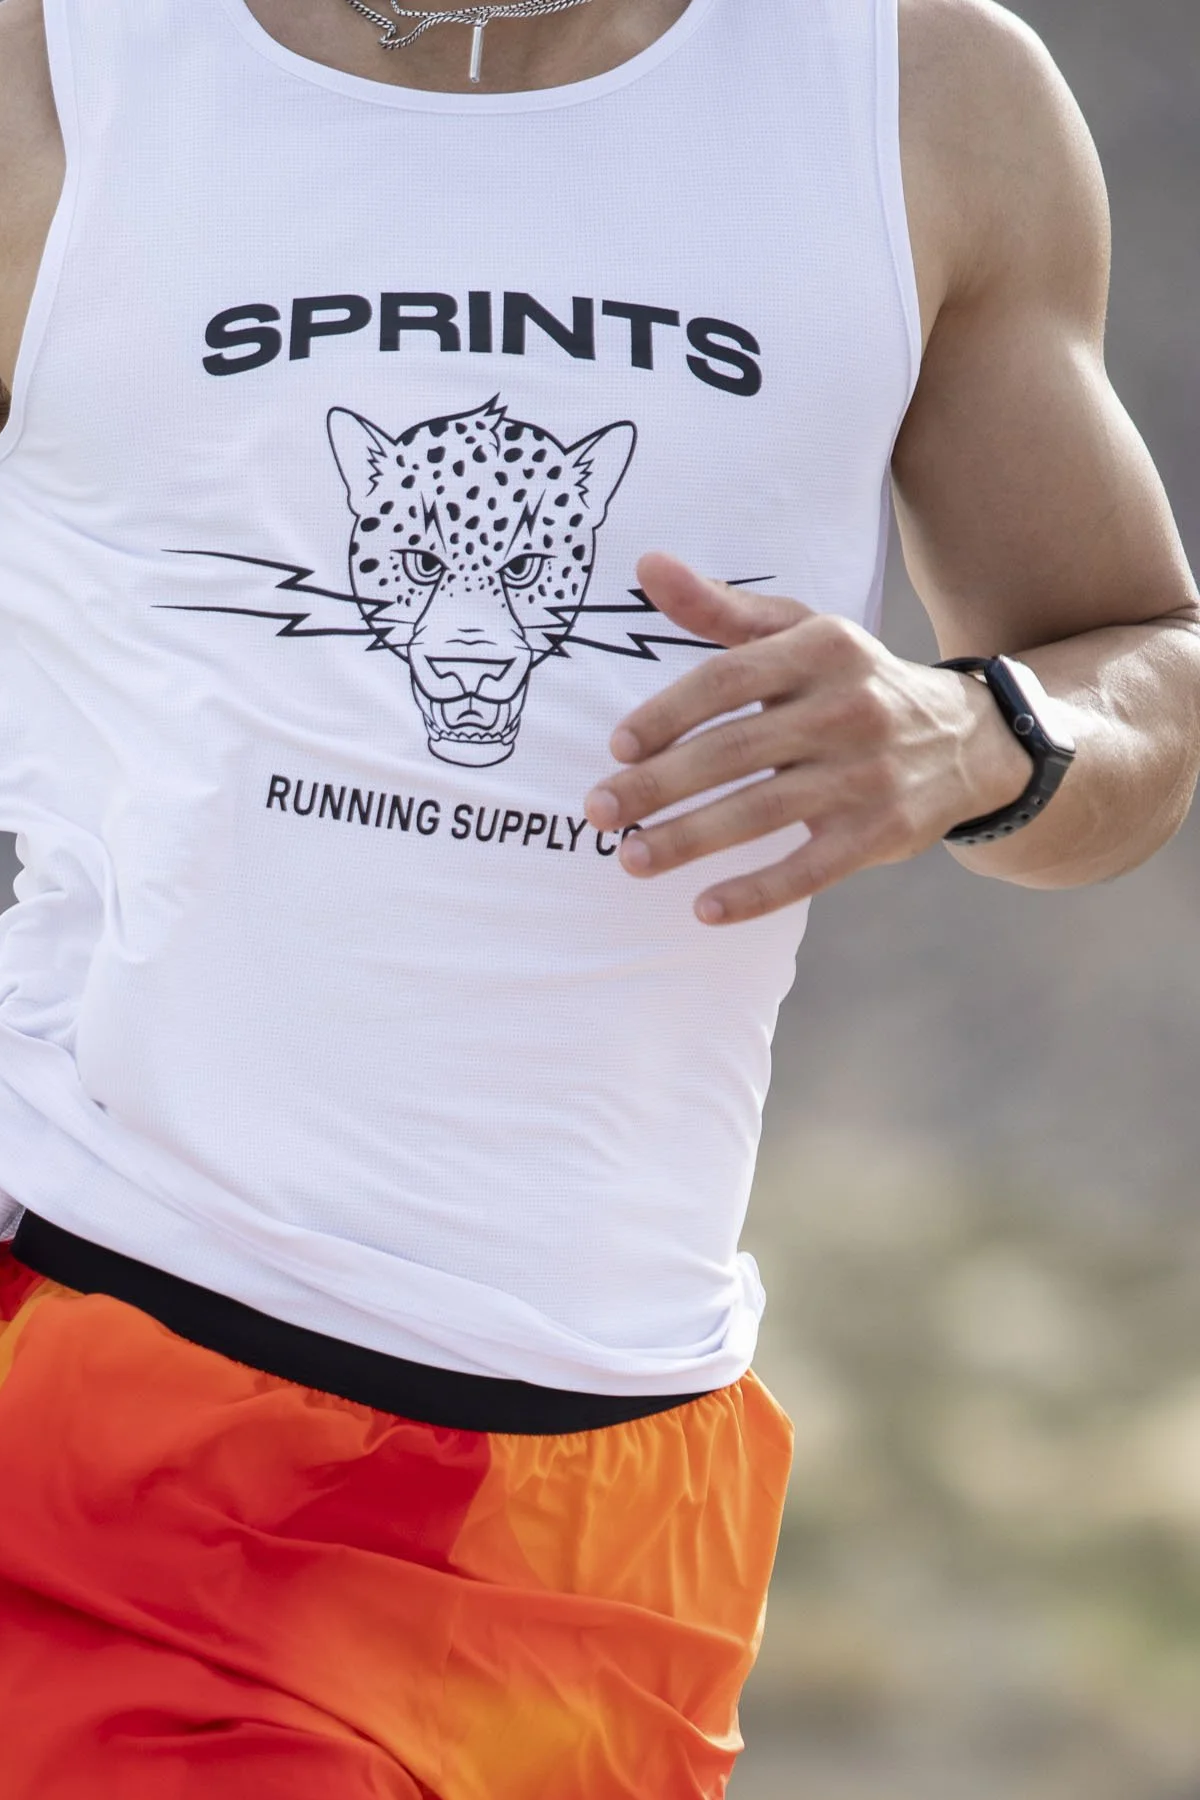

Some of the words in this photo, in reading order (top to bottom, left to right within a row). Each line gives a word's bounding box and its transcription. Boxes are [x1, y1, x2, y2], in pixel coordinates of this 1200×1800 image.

[201, 290, 762, 398] SPRINTS
[266, 774, 440, 836] RUNNING
[451, 803, 588, 852] SUPPLY
